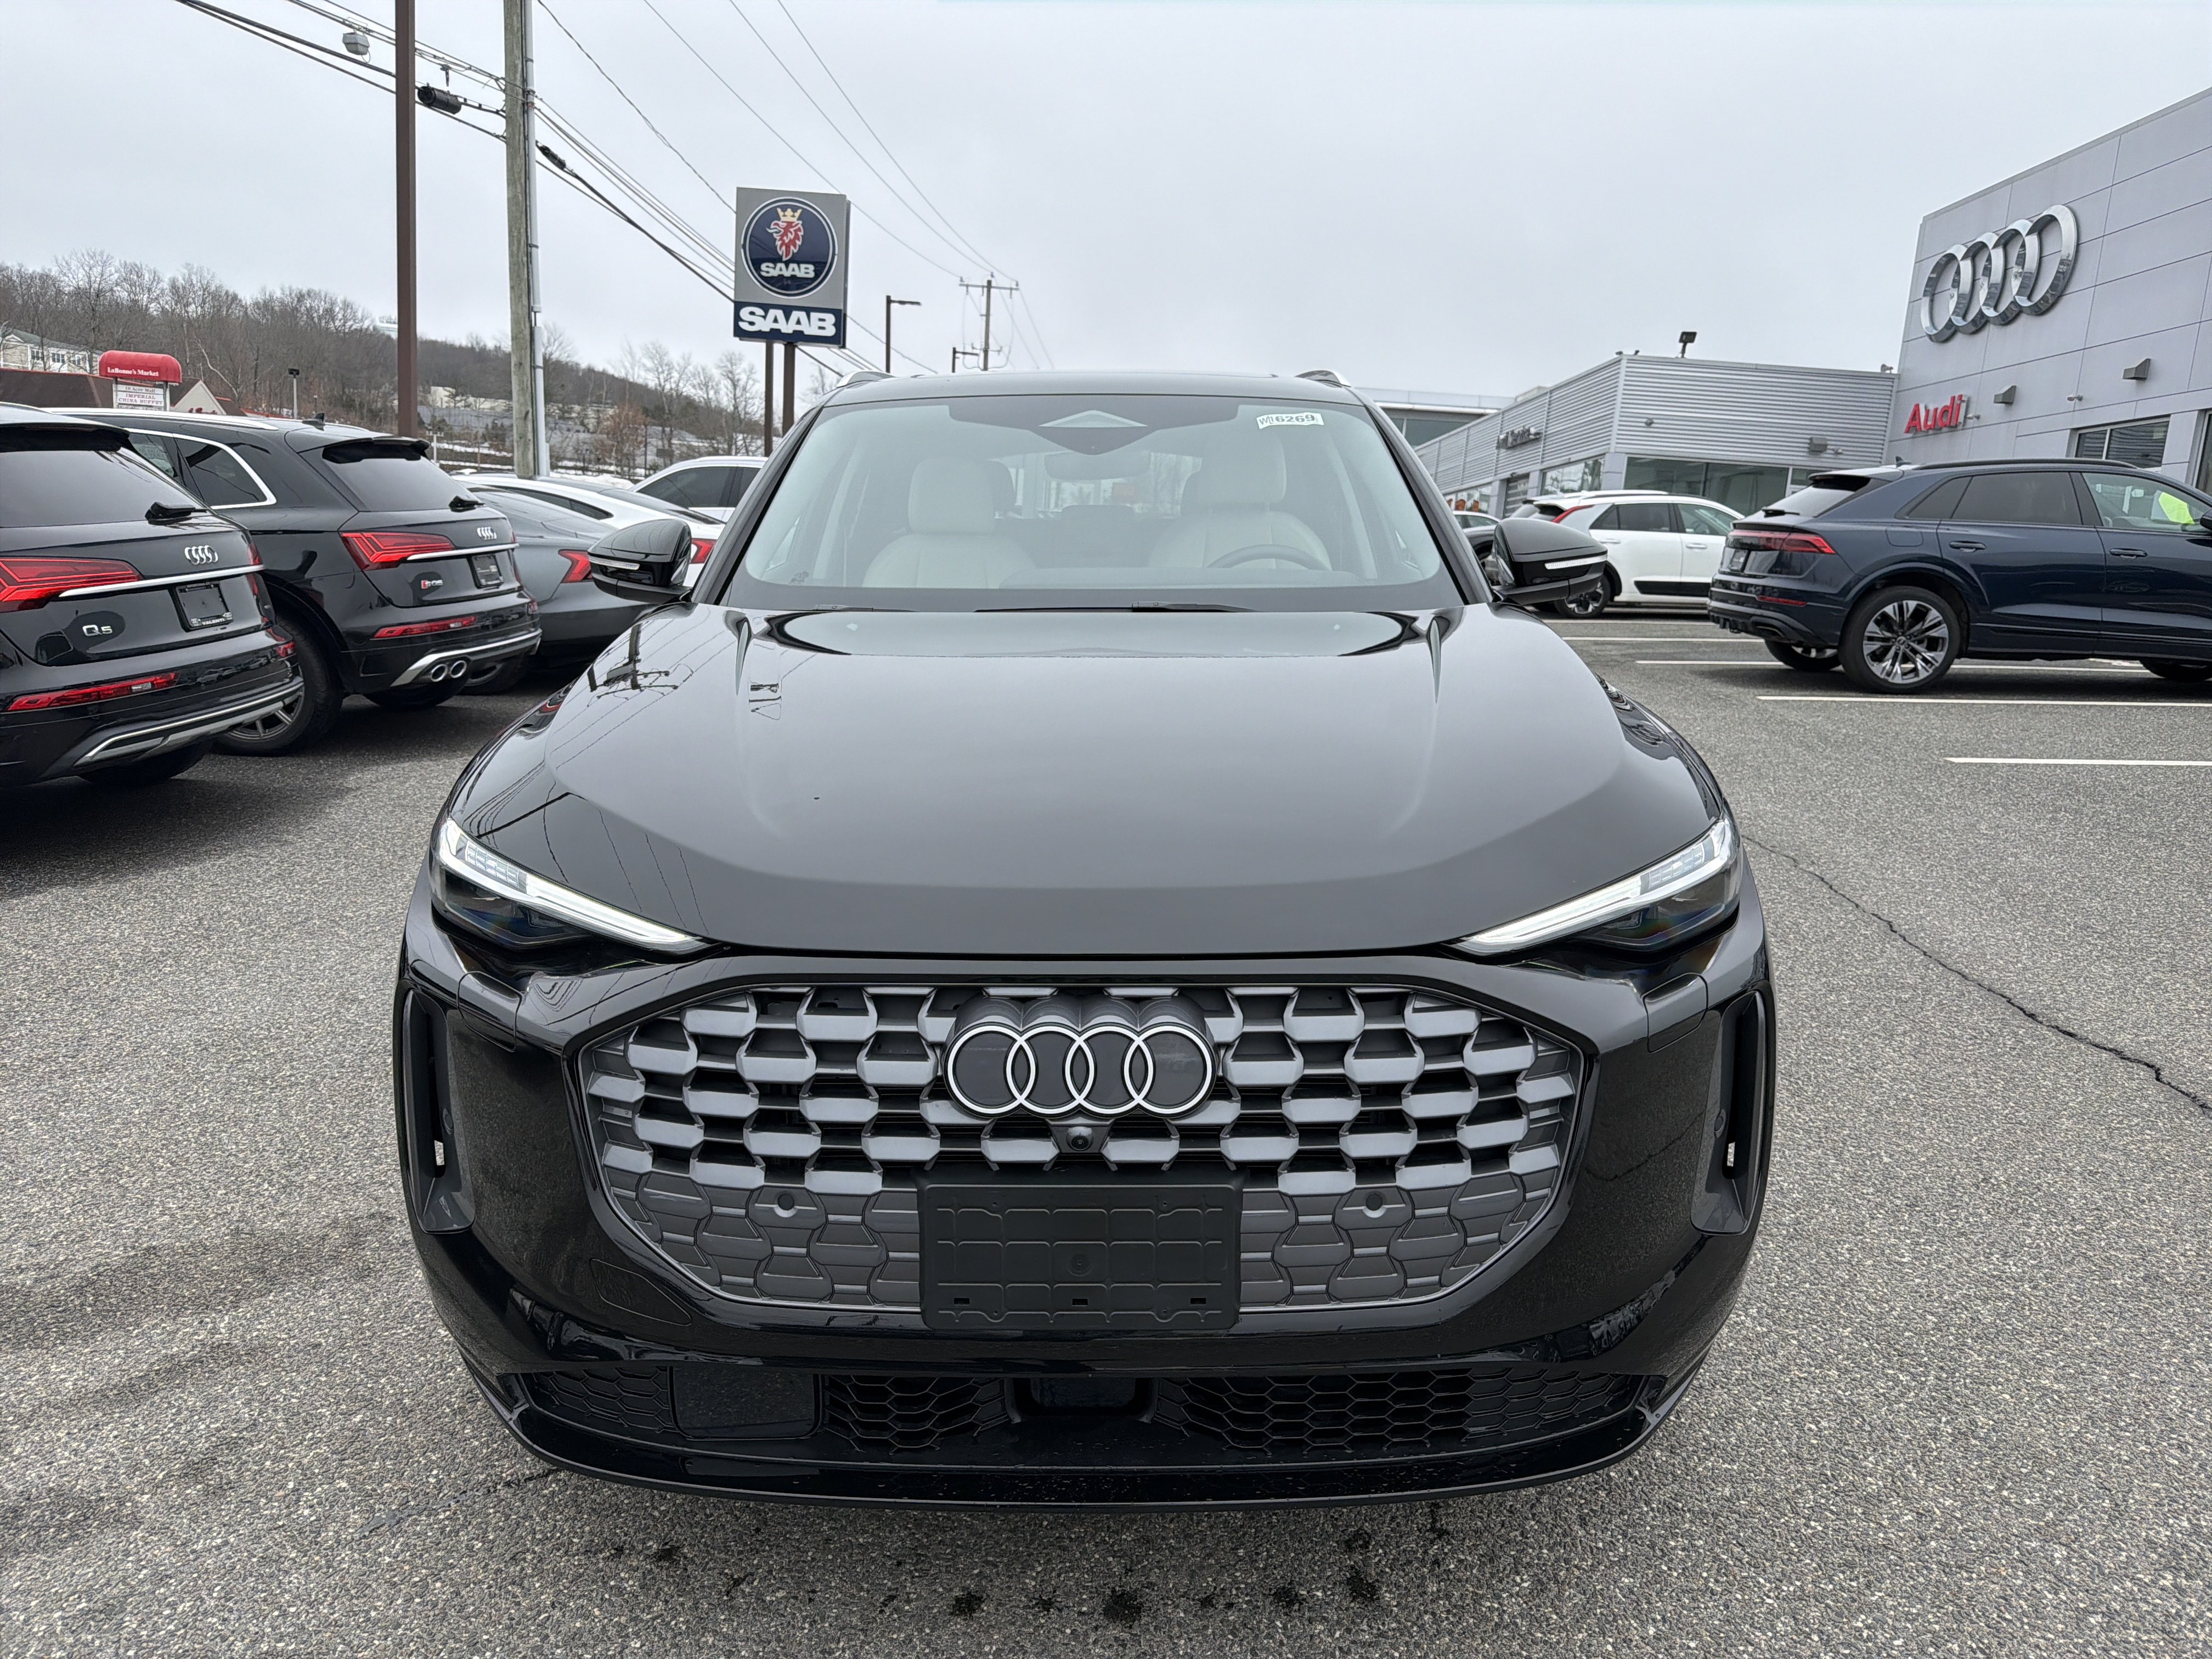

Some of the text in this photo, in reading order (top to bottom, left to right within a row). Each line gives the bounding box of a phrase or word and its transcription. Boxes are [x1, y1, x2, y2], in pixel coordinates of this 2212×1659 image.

[760, 262, 815, 278] SAAB
[738, 306, 836, 337] SAAB
[1904, 394, 1963, 434] Audi
[82, 624, 113, 636] Q5
